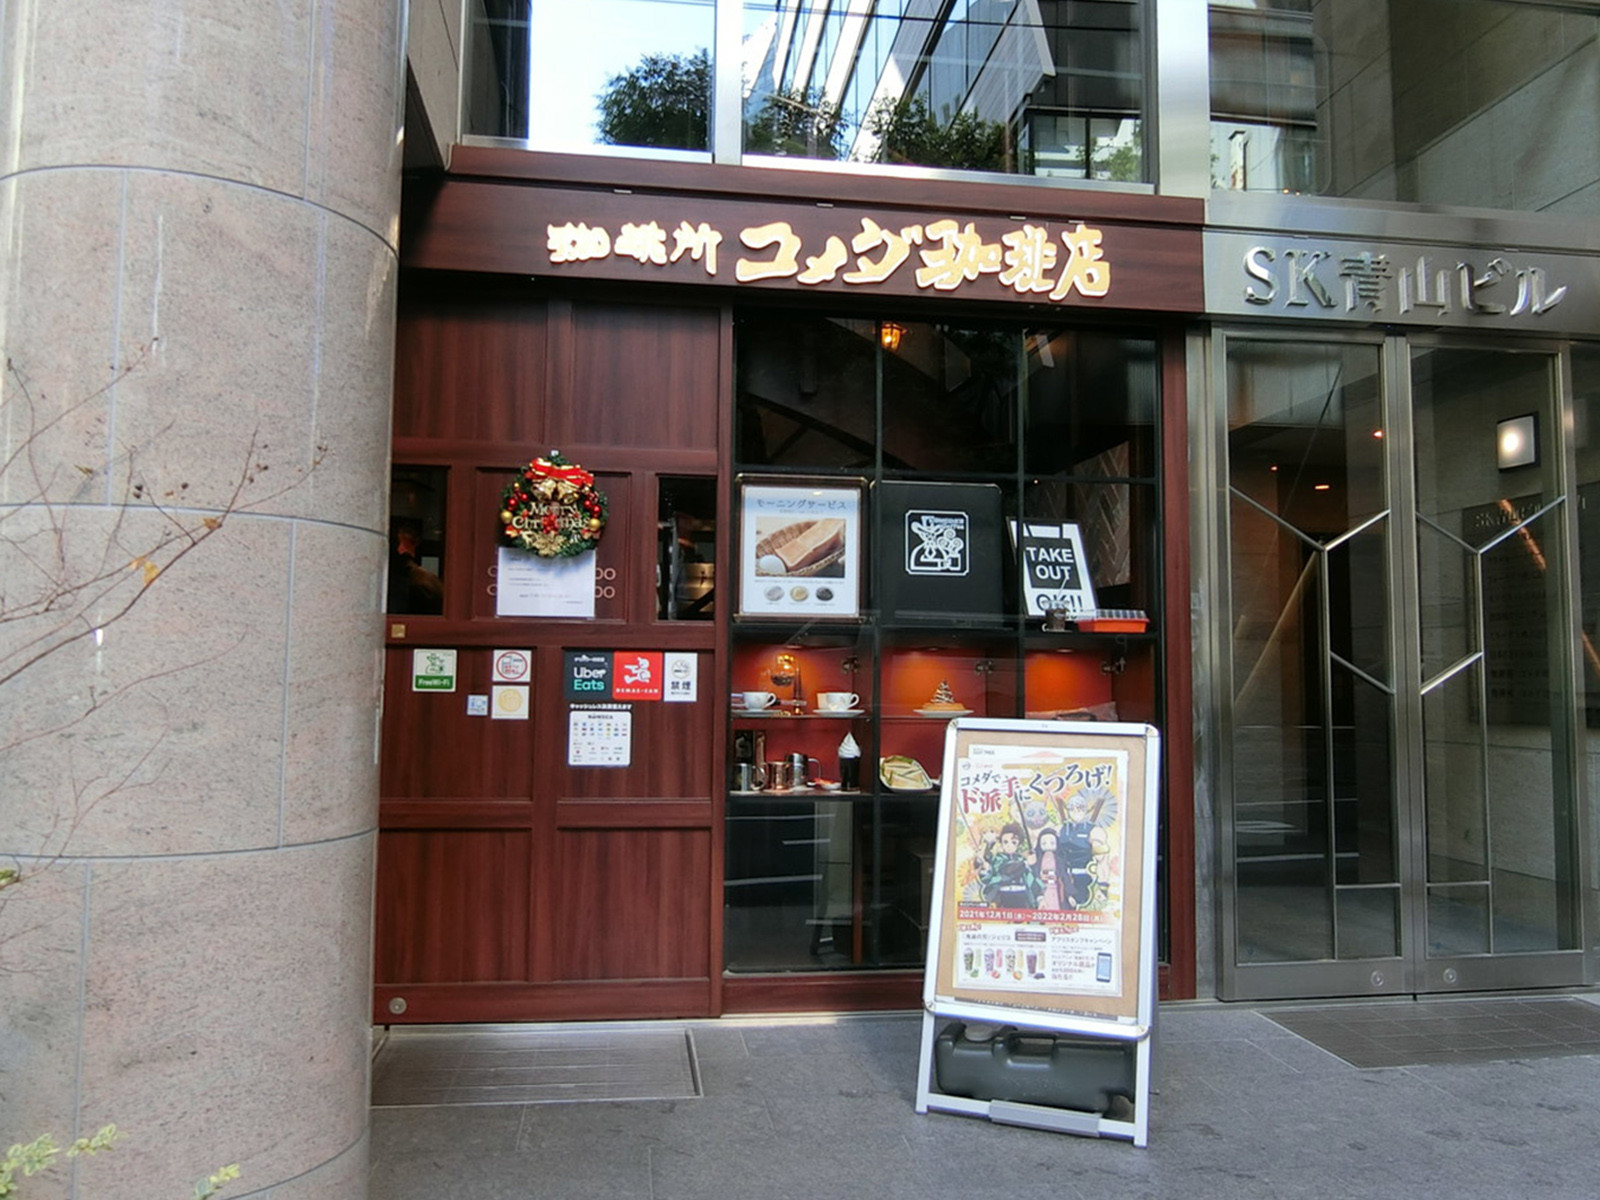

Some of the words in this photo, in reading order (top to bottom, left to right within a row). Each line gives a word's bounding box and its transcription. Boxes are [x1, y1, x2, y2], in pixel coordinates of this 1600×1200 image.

[546, 221, 722, 276] 珈琲所
[735, 217, 1112, 301] コメダ珈琲店
[1243, 246, 1567, 317] SK青山ビル
[529, 502, 578, 517] Merry
[757, 499, 847, 510] モーニングサービス
[1026, 547, 1075, 563] TAKE
[1035, 564, 1072, 581] OUT
[573, 667, 607, 679] Uber
[573, 679, 606, 691] Eats
[960, 770, 1001, 788] コメダで
[960, 777, 1032, 814] ド派手に
